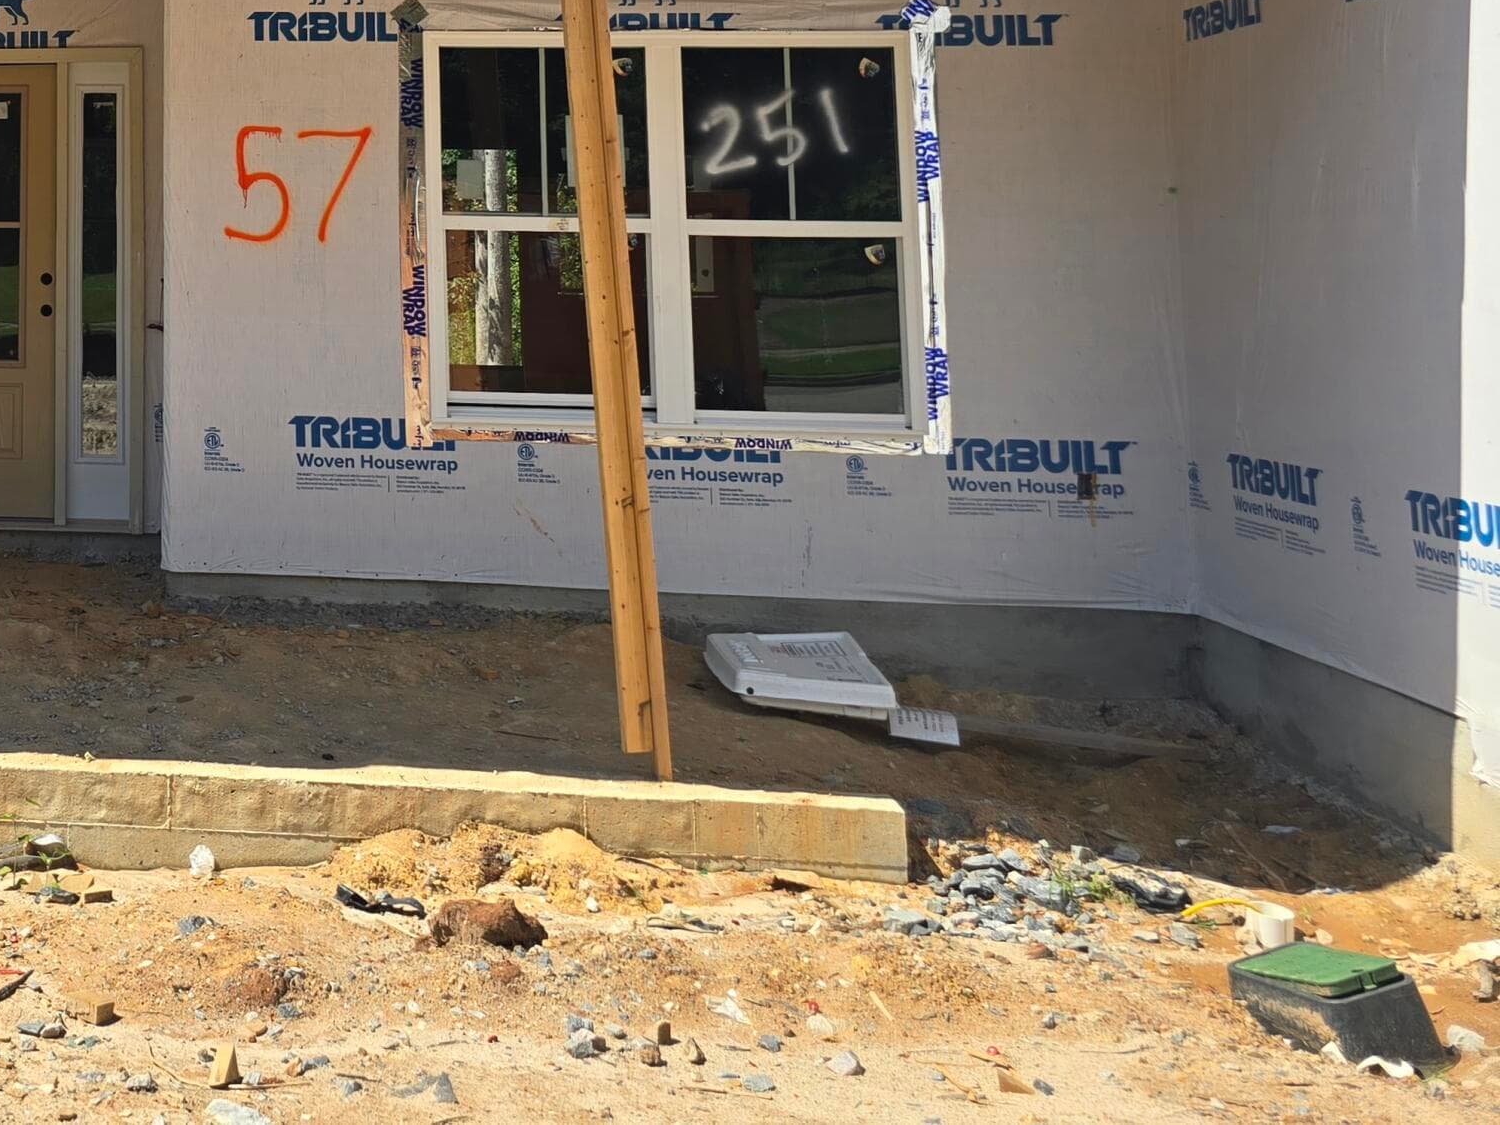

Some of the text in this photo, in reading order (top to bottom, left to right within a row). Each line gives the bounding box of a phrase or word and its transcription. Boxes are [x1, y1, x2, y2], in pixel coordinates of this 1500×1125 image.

[701, 86, 849, 175] 251
[224, 125, 374, 242] 57
[296, 453, 458, 474] Woven Housewrap
[681, 466, 784, 487] Housewrap
[947, 476, 1125, 498] Woven Houserap
[1233, 495, 1264, 517] Woven
[1265, 503, 1319, 535] Housewrap
[1413, 538, 1458, 568] Woven
